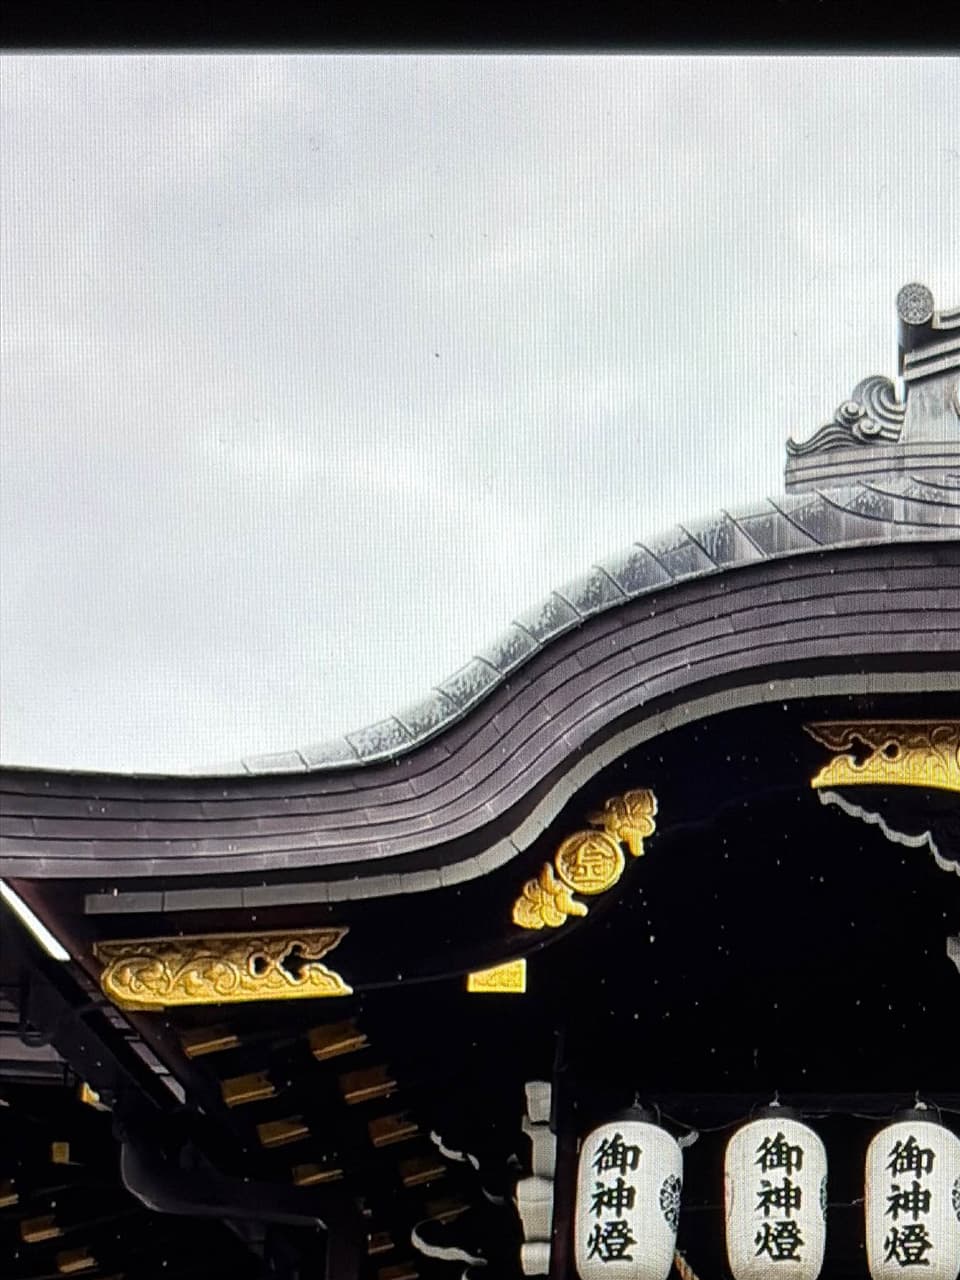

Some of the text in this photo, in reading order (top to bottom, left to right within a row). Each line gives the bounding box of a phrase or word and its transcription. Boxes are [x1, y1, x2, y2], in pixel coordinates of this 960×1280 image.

[587, 1132, 642, 1263] 御神燈
[754, 1132, 805, 1264] 御神燈
[883, 1136, 937, 1268] 御神燈
